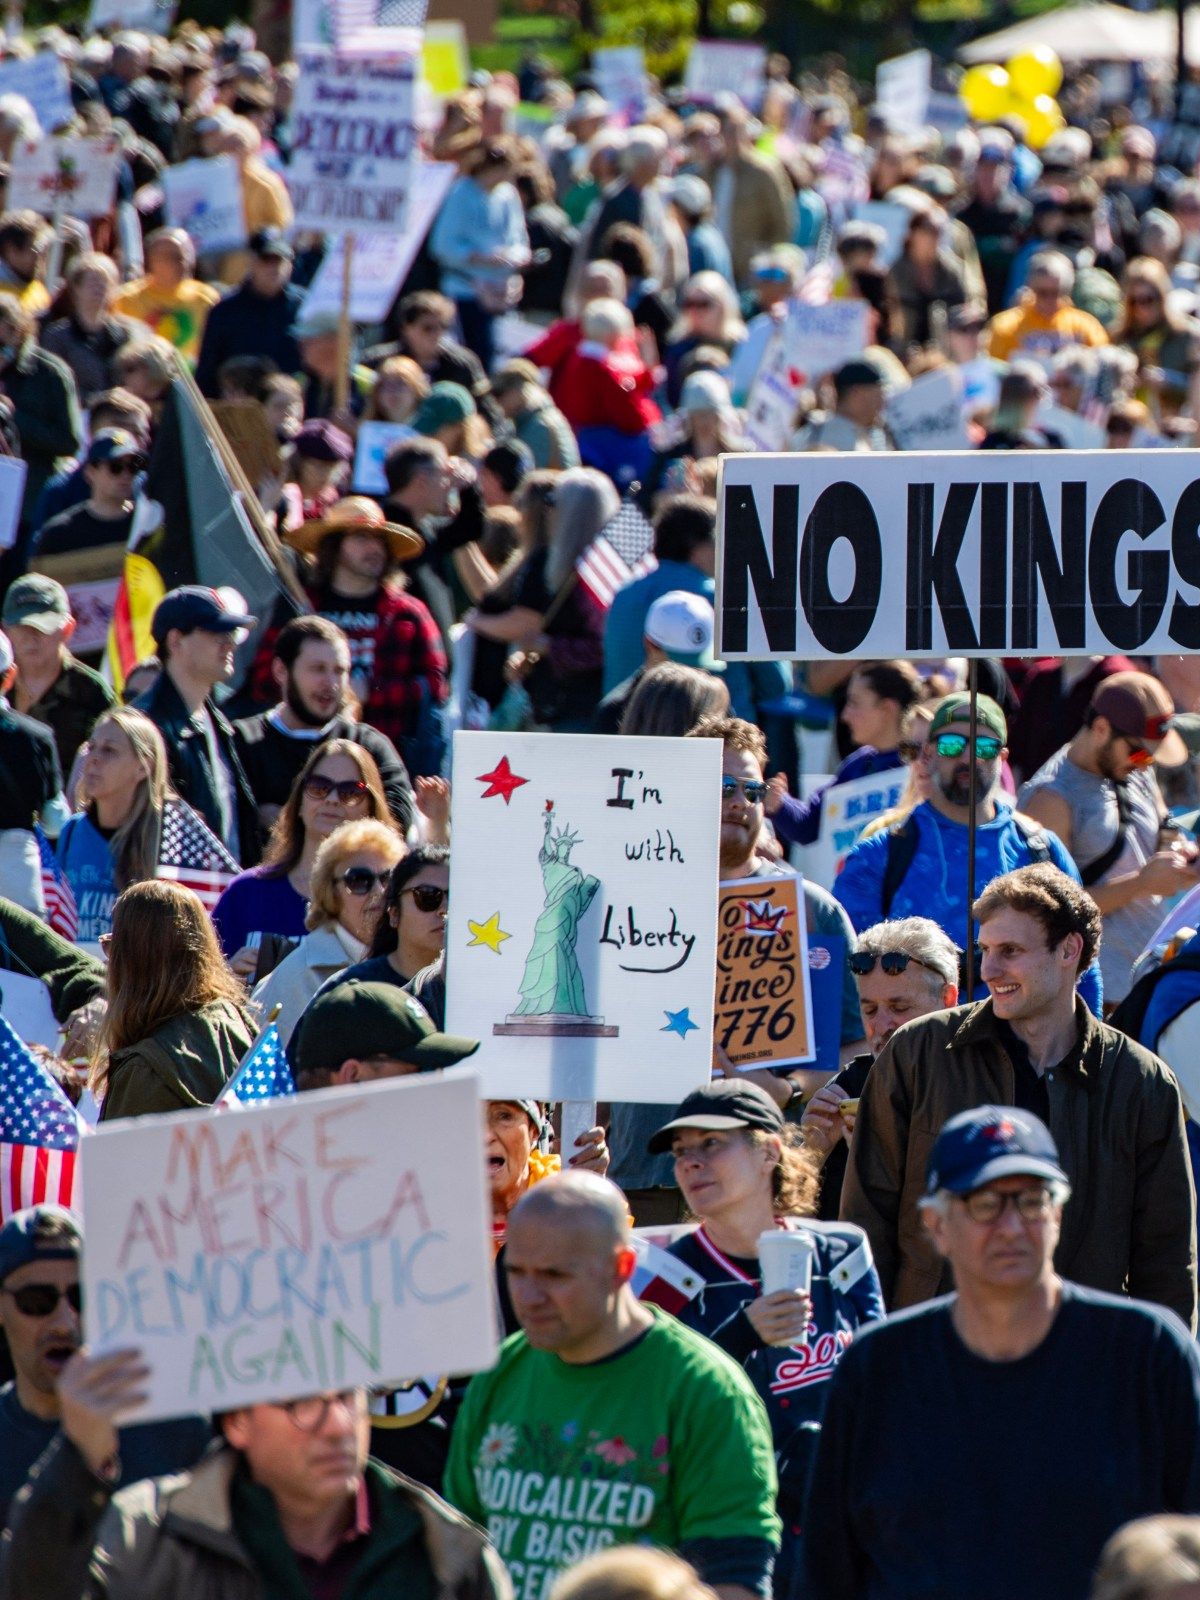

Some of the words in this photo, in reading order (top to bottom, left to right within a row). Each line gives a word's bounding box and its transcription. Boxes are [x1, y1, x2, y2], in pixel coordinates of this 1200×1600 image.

[722, 481, 882, 654] NO
[607, 768, 662, 809] I'm
[625, 829, 685, 863] with
[599, 905, 696, 974] Liberty
[717, 930, 796, 972] ings
[717, 963, 795, 1005] ince
[165, 1101, 375, 1187] MAKE
[117, 1170, 432, 1269] AMERICA
[96, 1230, 471, 1341] DEMOCRATIC
[189, 1302, 381, 1395] AGAIN
[487, 1515, 521, 1556] BY
